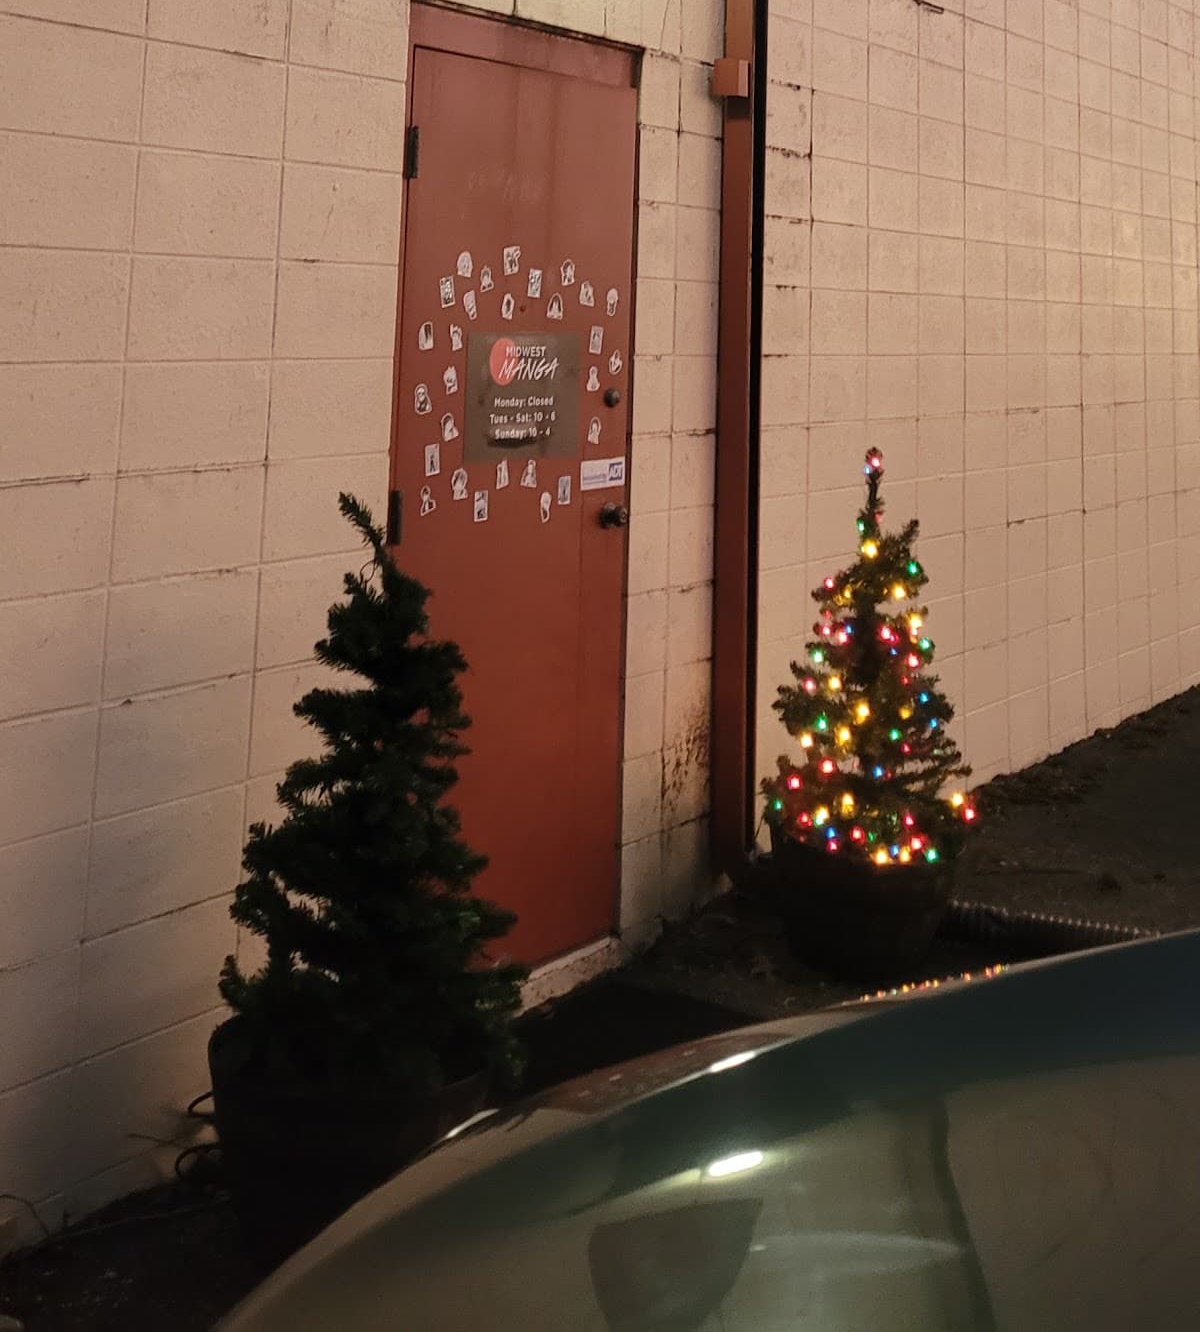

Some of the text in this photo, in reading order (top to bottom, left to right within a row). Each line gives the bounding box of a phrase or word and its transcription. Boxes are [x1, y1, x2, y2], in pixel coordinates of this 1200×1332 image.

[506, 346, 546, 357] MIDWEST
[498, 357, 559, 380] MANGA
[494, 395, 554, 408] Monday: Closed
[490, 413, 508, 424] Tues
[516, 412, 532, 422] Sat:
[533, 411, 543, 422] 10
[494, 429, 527, 440] Sunday:
[528, 427, 537, 437] 10
